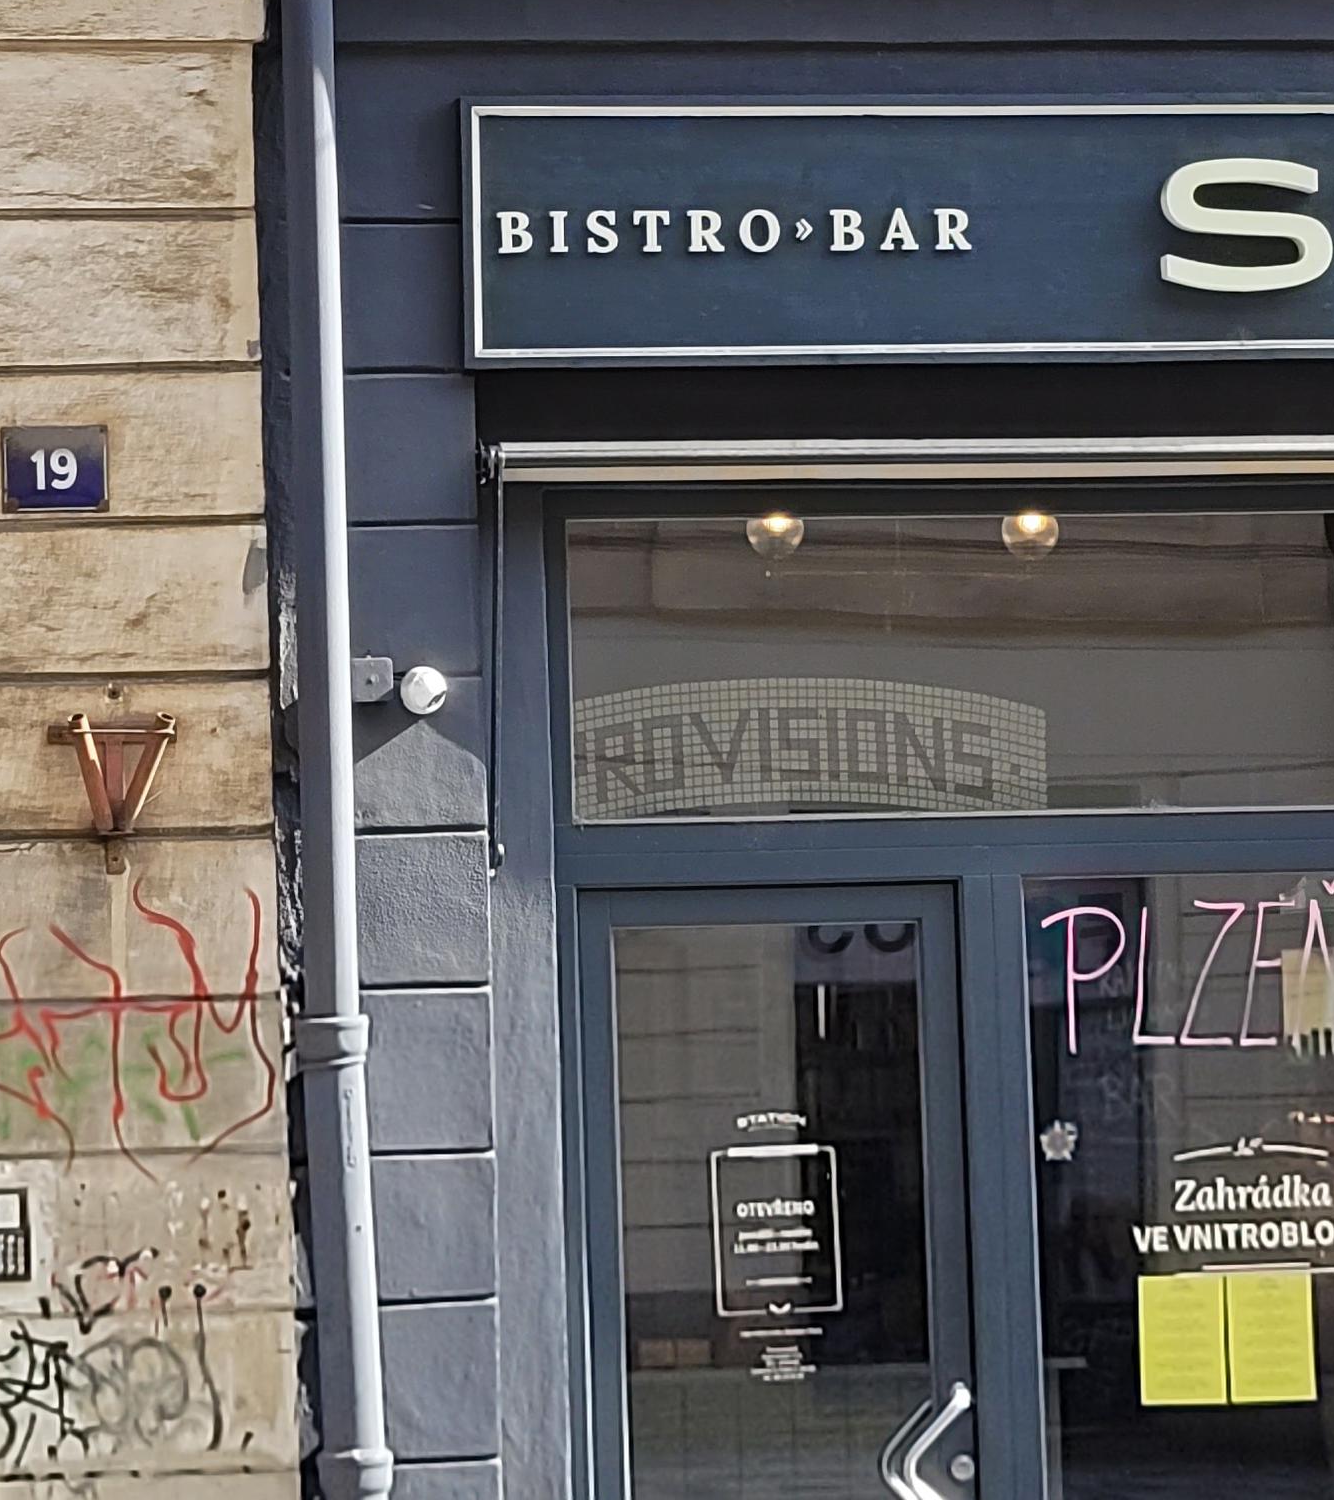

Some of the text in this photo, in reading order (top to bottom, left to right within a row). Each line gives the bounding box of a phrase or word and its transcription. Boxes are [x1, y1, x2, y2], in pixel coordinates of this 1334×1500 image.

[496, 207, 973, 255] BISTRO BAR
[30, 447, 78, 490] 19
[1174, 1174, 1334, 1212] Zahrádka
[1132, 1225, 1169, 1253] VE
